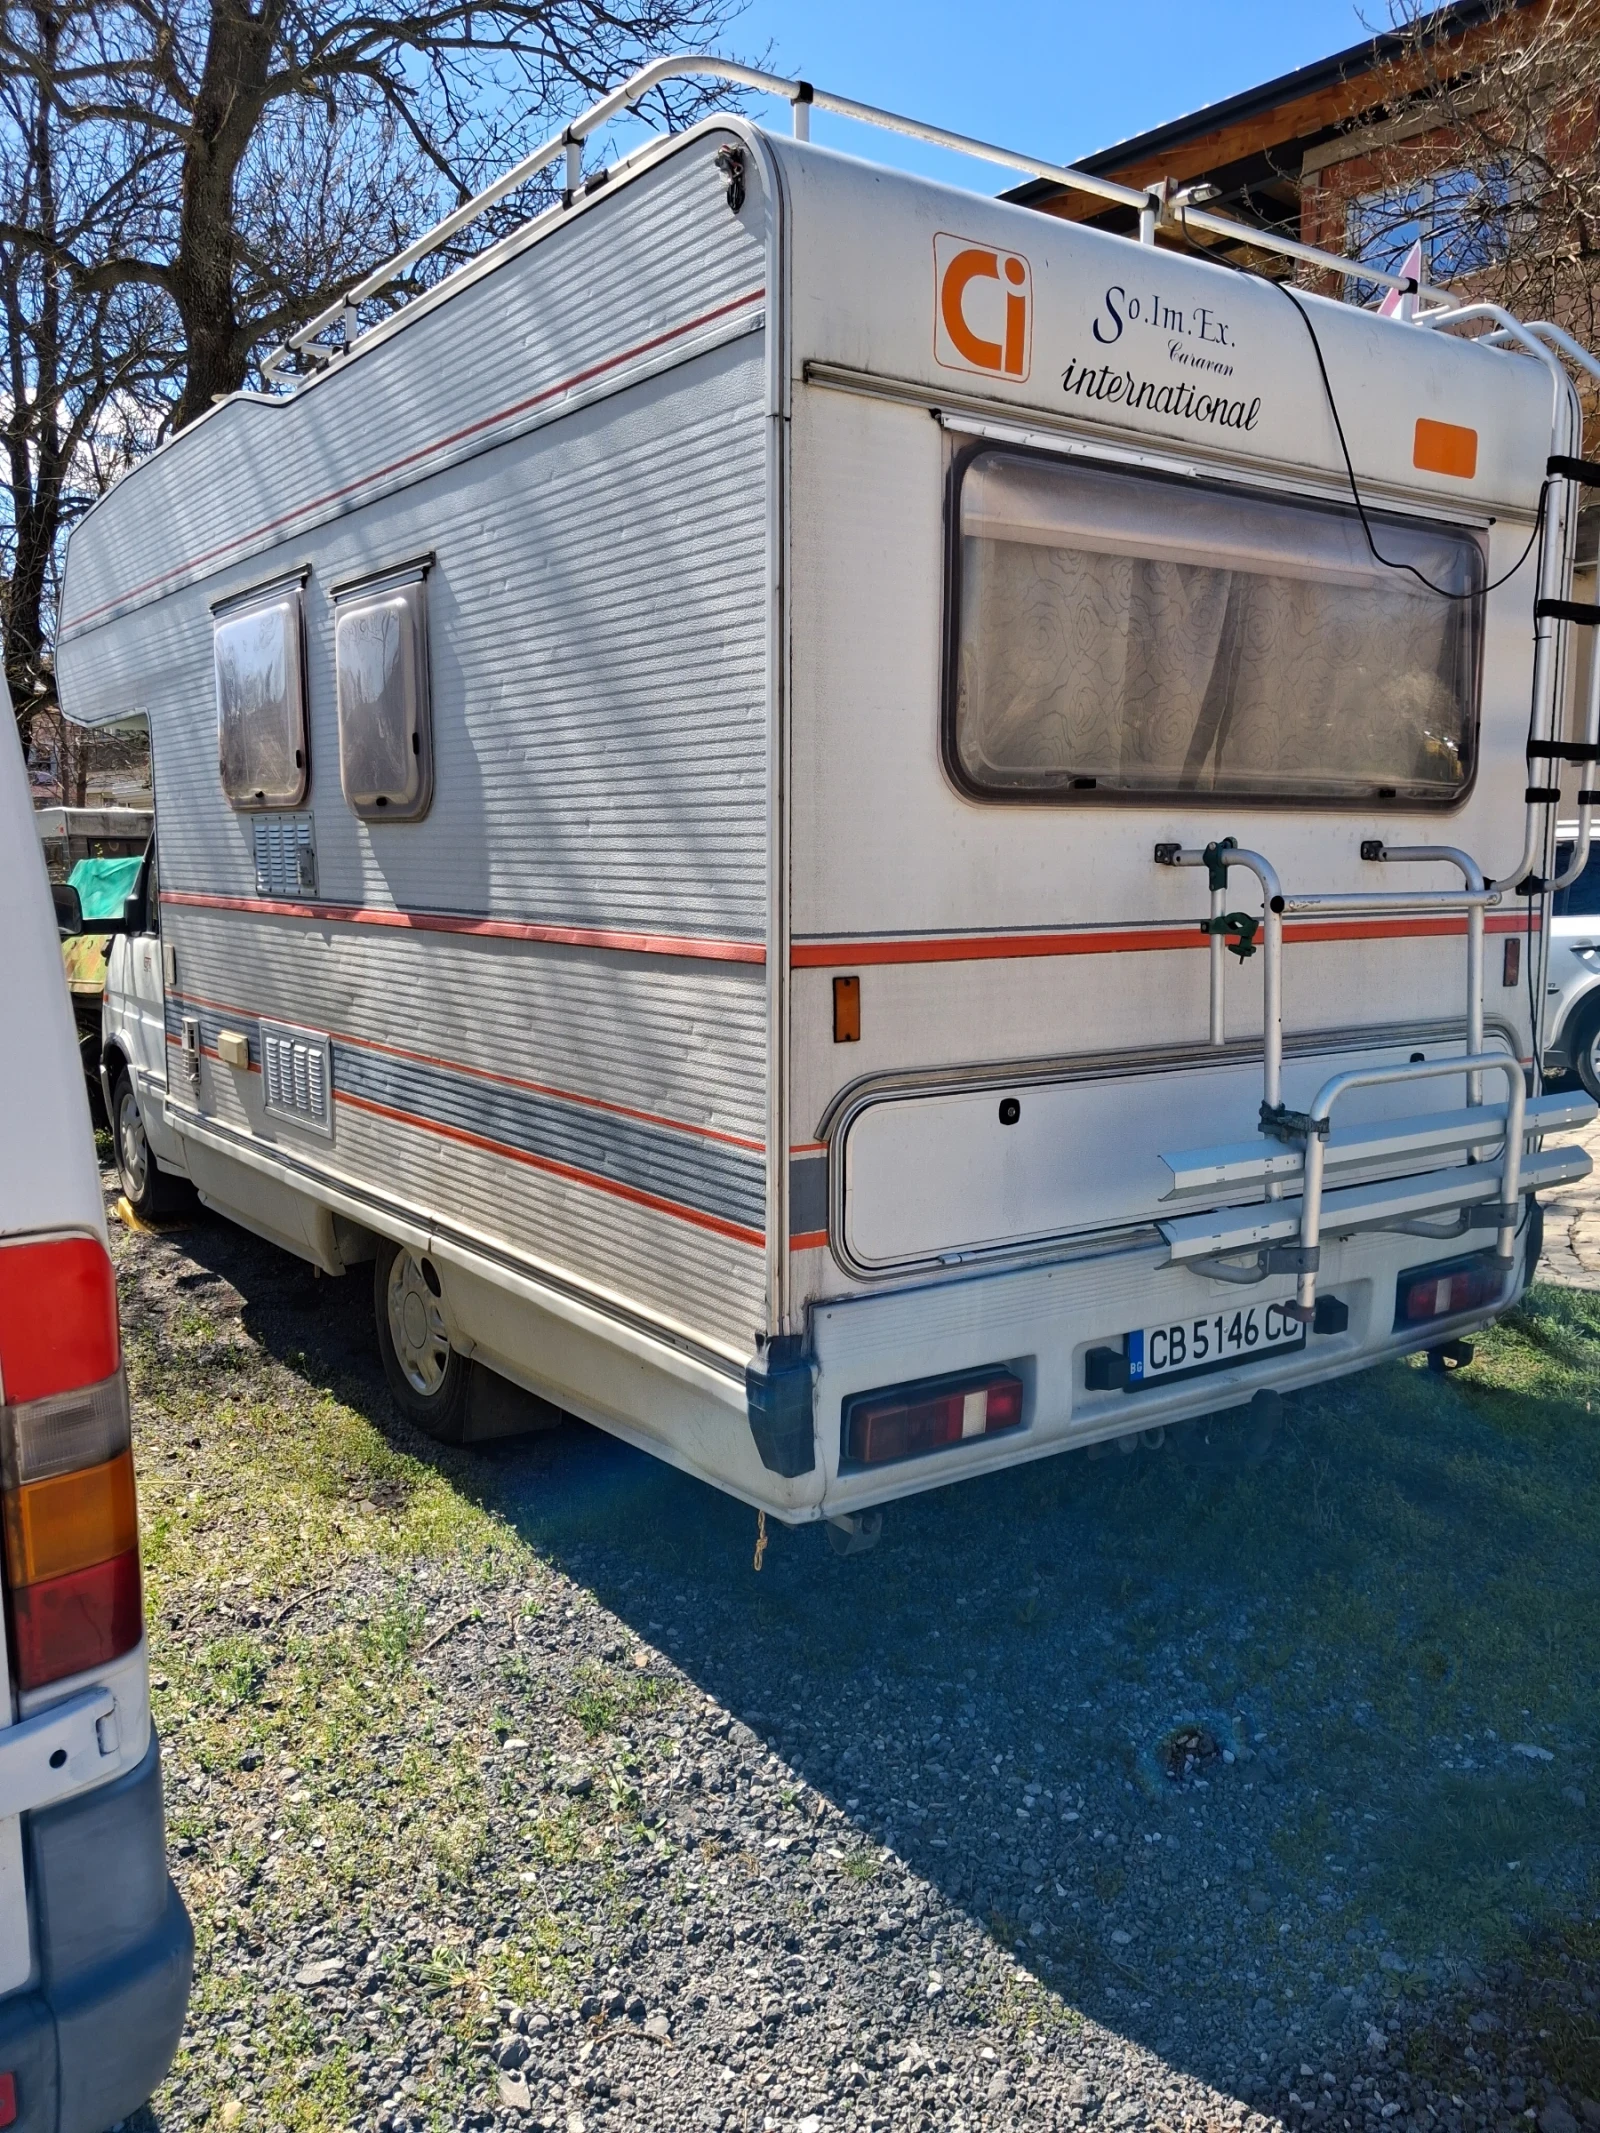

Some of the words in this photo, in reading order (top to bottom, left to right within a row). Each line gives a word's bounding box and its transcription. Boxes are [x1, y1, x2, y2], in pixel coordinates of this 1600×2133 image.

[1167, 339, 1234, 376] Caravan
[1061, 358, 1261, 432] international
[1130, 1361, 1143, 1375] BG
